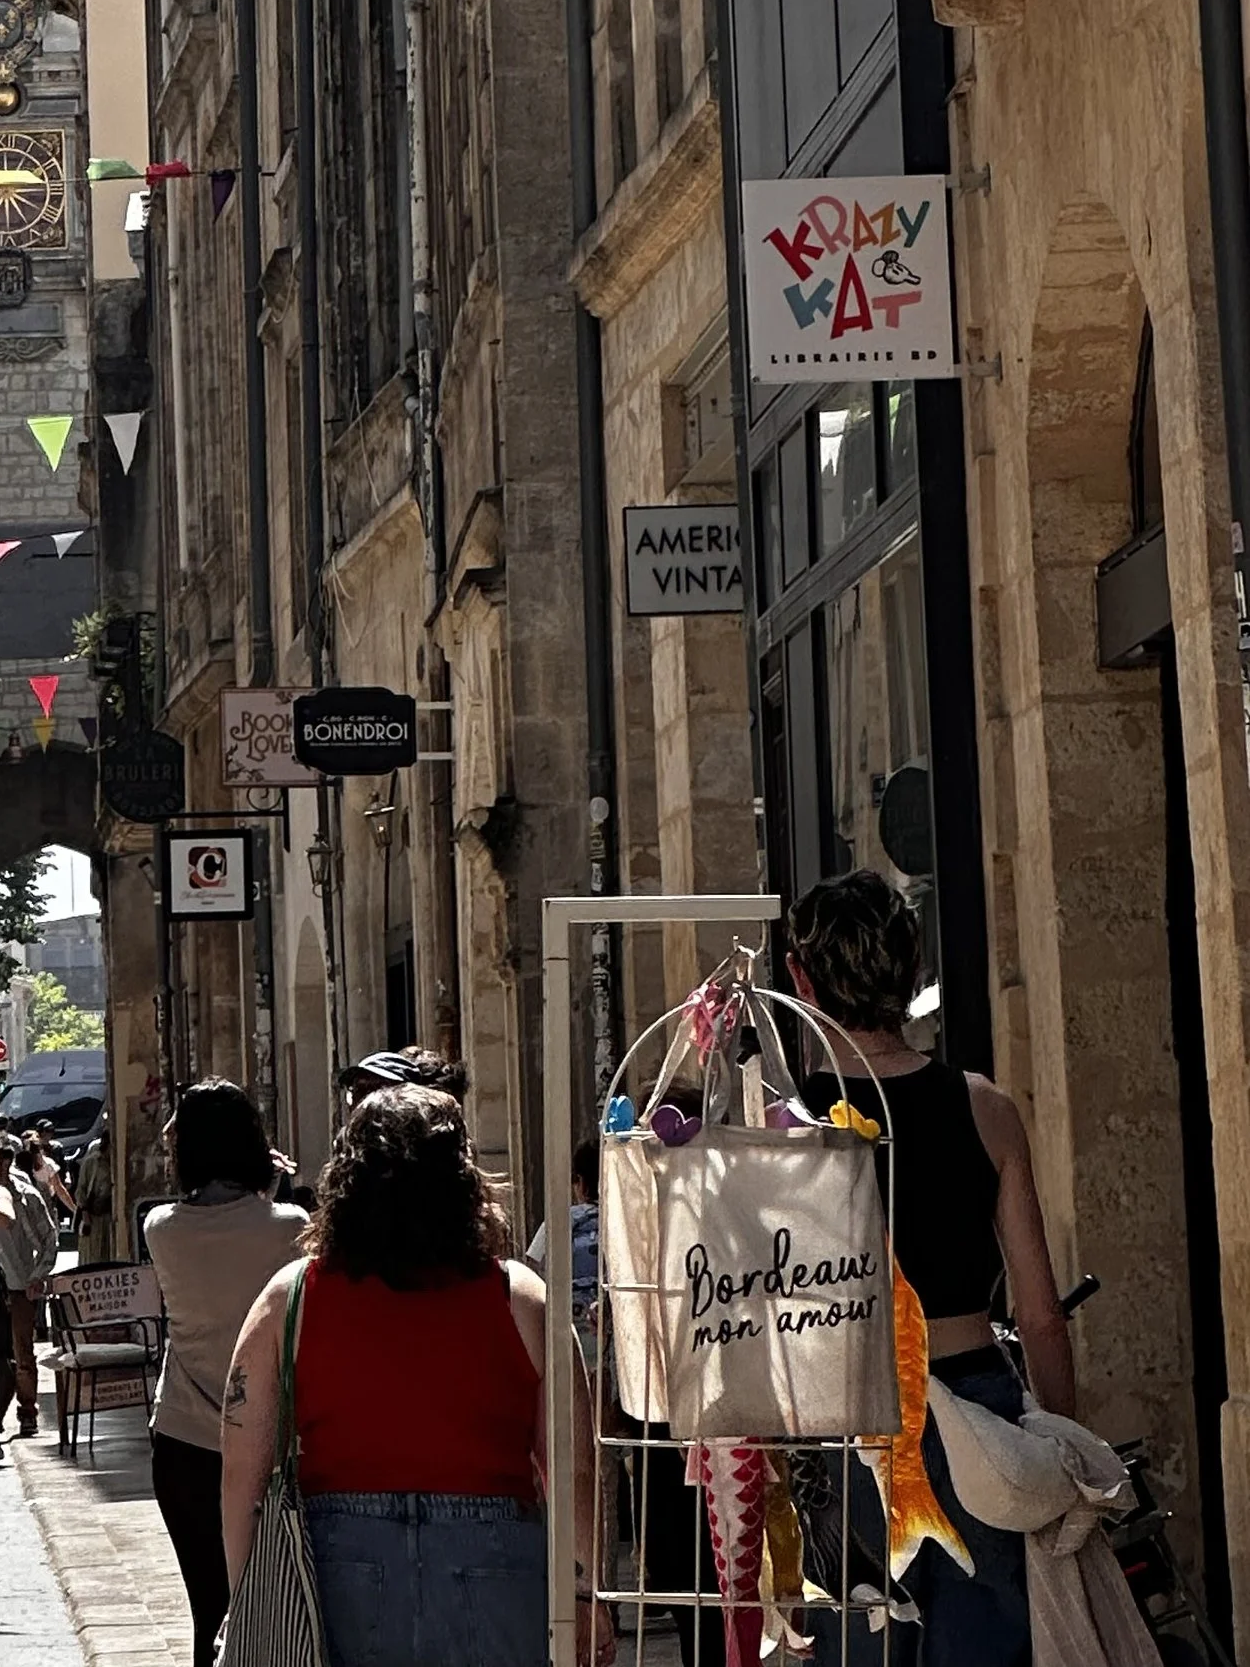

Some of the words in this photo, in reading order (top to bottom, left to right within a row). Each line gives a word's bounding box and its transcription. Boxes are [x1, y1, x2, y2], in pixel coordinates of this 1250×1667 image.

[762, 195, 930, 282] KRAZY
[783, 252, 922, 340] KAT
[771, 351, 893, 364] LIBRAIRIE
[911, 350, 937, 361] BD
[652, 565, 743, 595] VINTA
[303, 722, 409, 741] BONENDROI
[246, 734, 292, 762] LOVE
[71, 1272, 140, 1293] COOKIES
[685, 1227, 877, 1319] Bordeaux
[90, 1300, 128, 1312] MAISON
[692, 1318, 763, 1352] mon
[776, 1294, 878, 1335] amour
